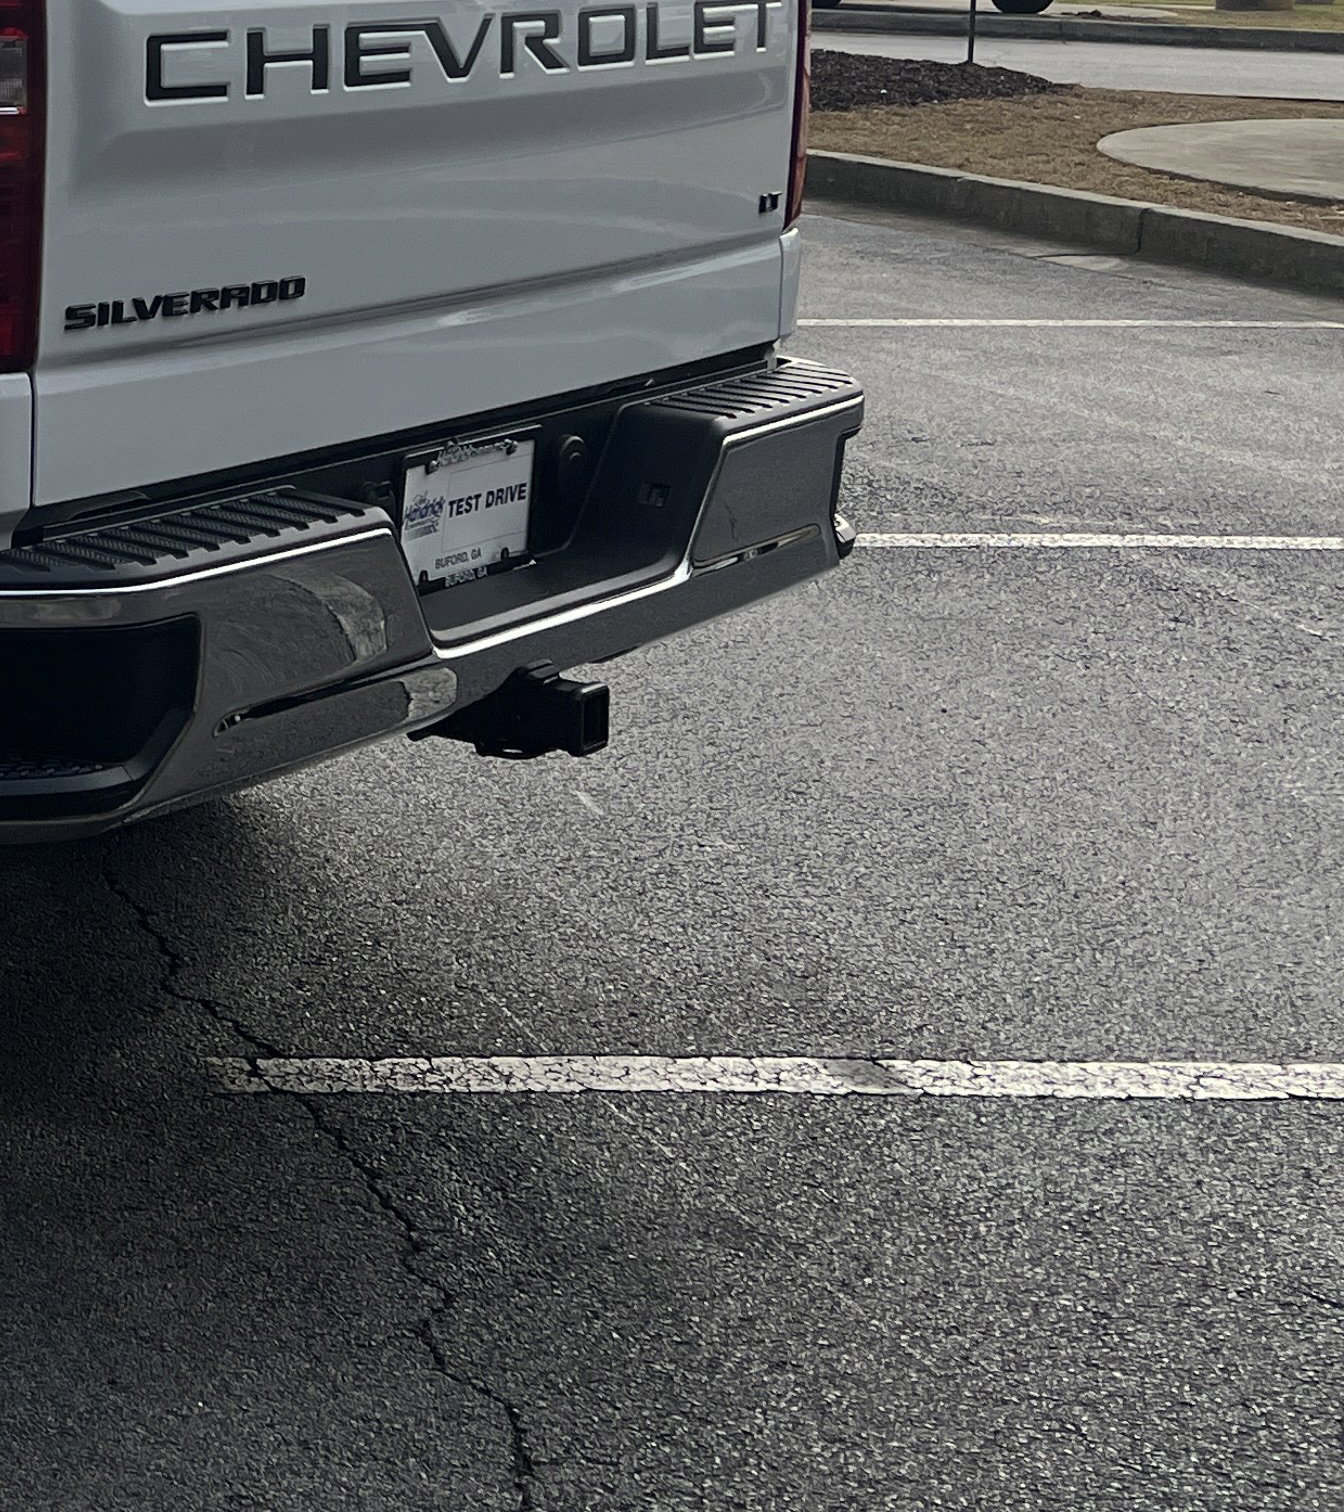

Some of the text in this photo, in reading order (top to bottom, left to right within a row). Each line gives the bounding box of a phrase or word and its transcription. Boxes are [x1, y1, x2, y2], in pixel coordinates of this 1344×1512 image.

[758, 191, 783, 214] LT
[64, 275, 306, 331] SILVERADO
[448, 493, 482, 518] TEST
[485, 482, 528, 509] DRIVE
[470, 547, 482, 560] GA
